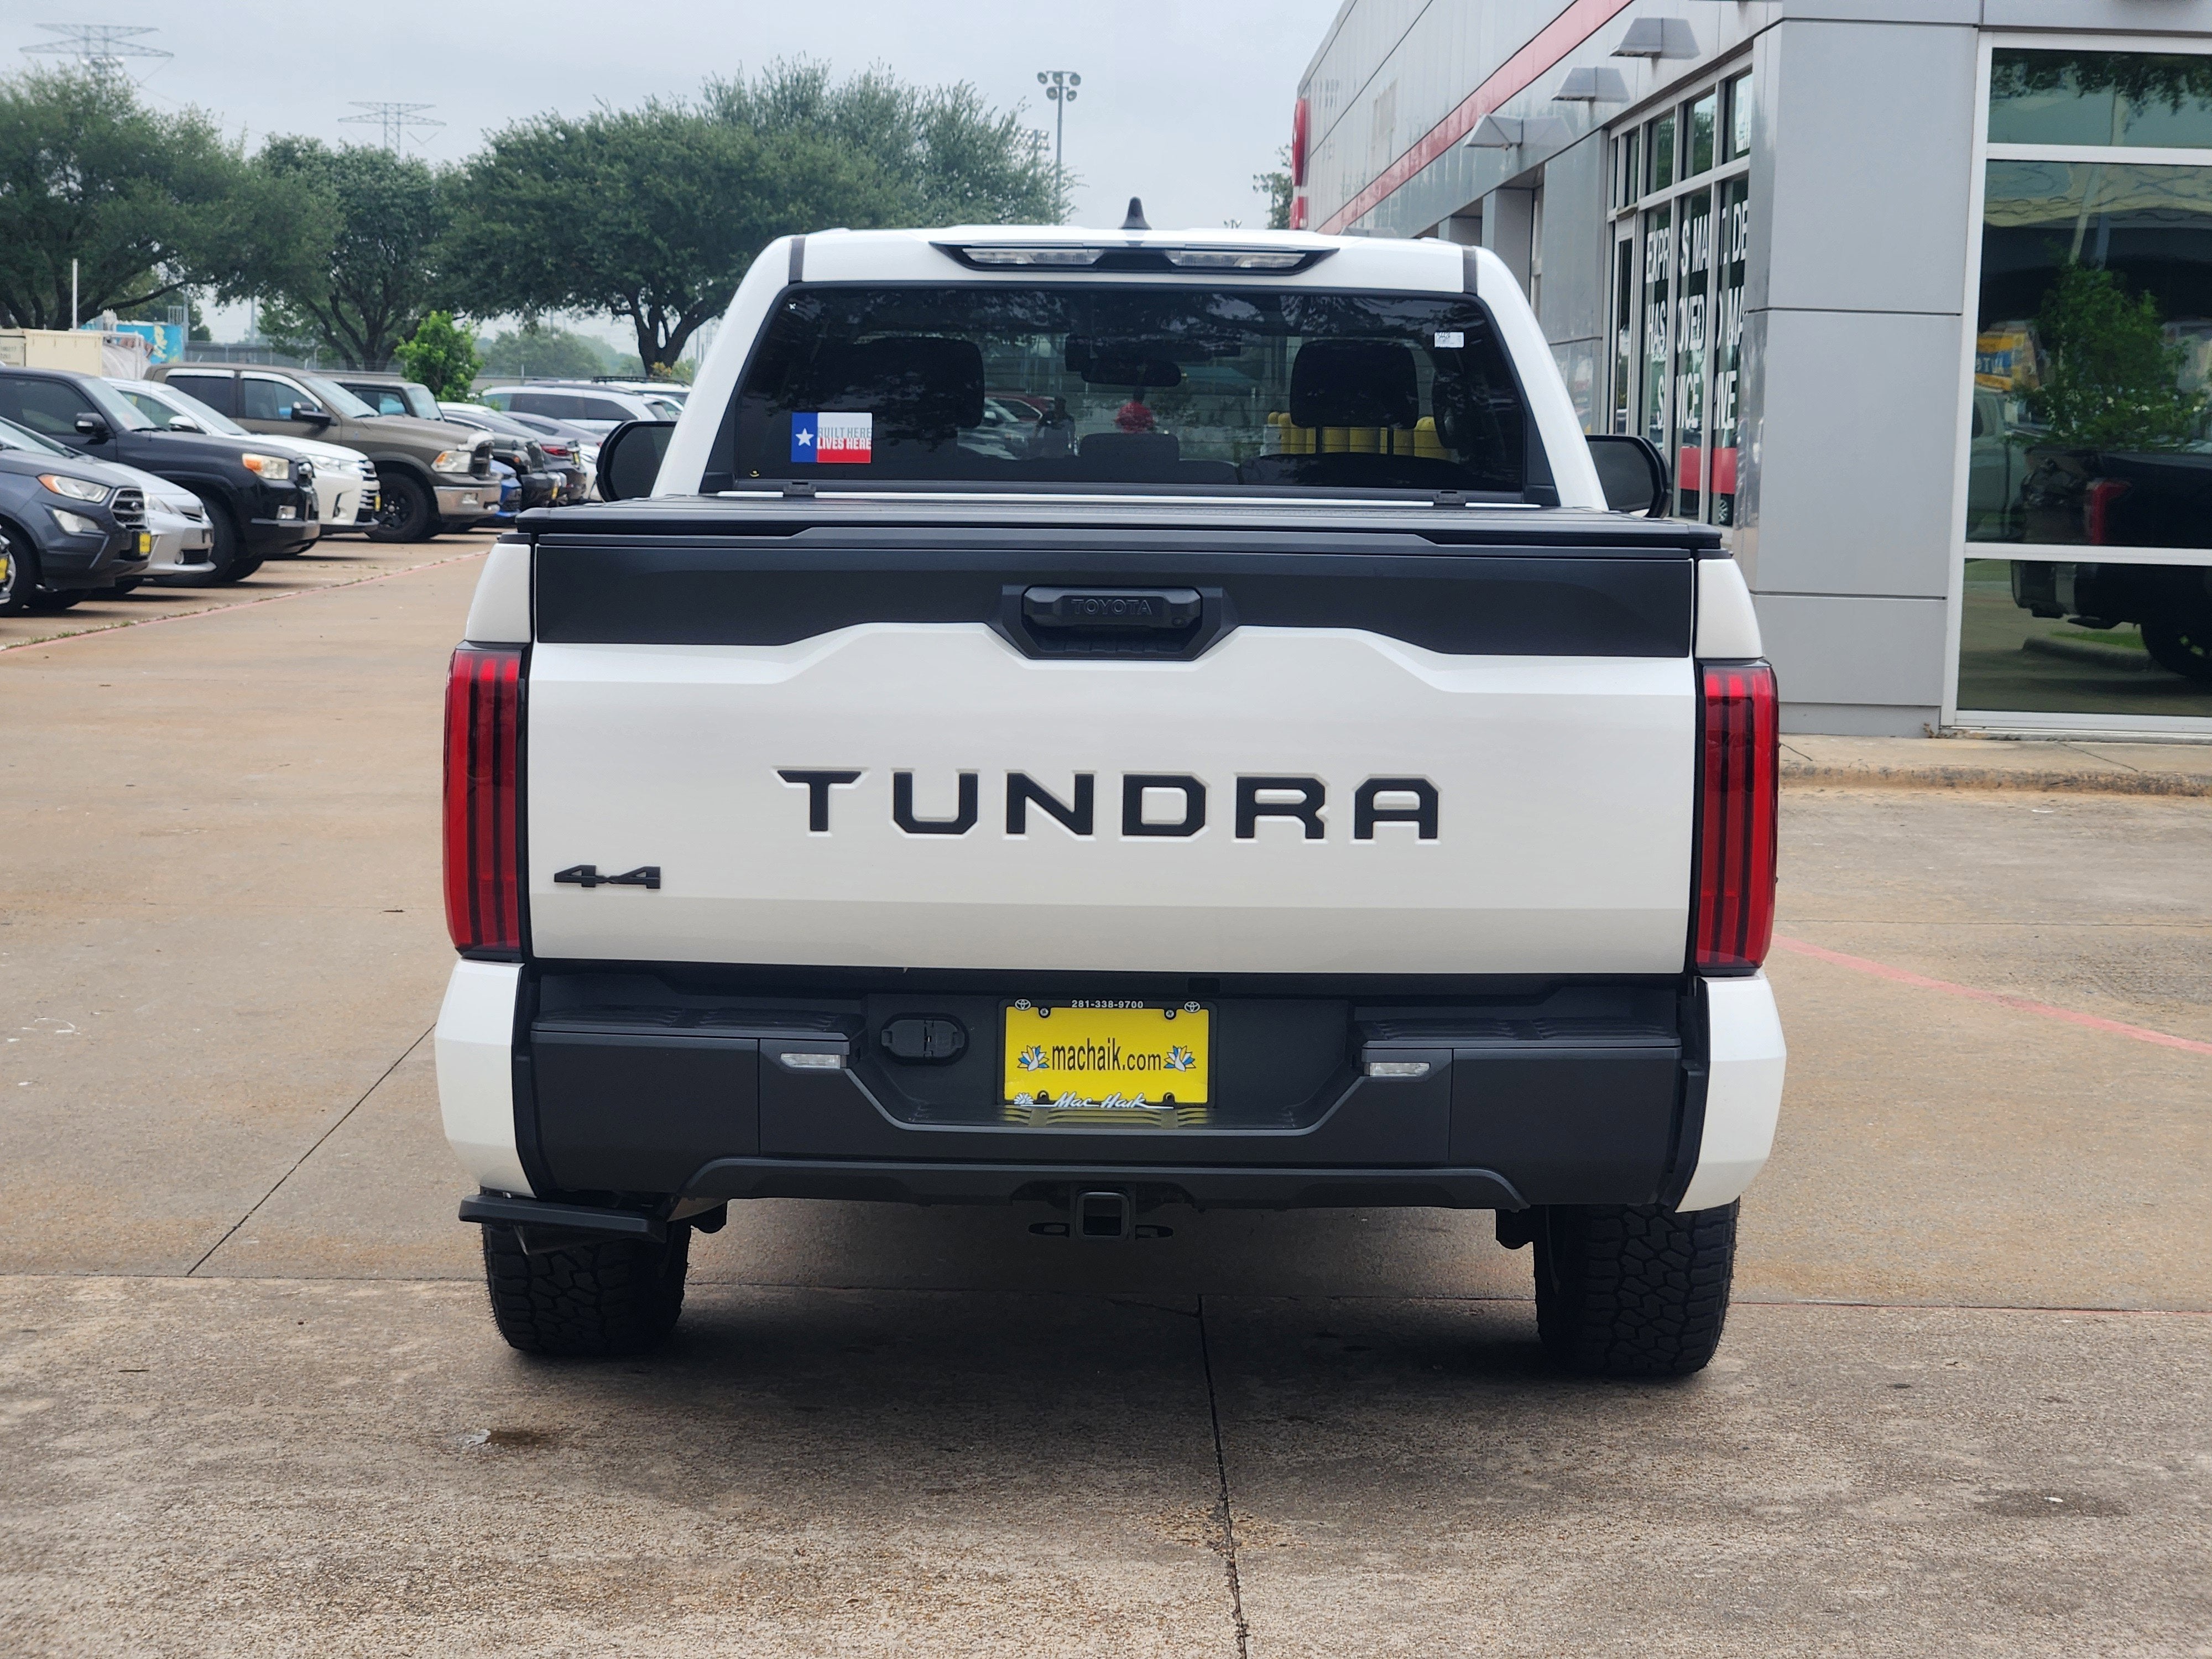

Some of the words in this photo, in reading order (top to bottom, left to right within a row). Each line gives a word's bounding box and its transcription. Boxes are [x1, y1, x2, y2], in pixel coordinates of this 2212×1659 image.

[1646, 218, 1690, 283] EXPRS
[1732, 200, 1748, 263] DE
[1646, 300, 1666, 355] HAS
[1677, 293, 1705, 354] OVED
[1657, 372, 1699, 430] SVICE
[1714, 370, 1736, 430] IVE
[817, 437, 844, 450] LIVES
[846, 438, 872, 450] HERE
[818, 427, 845, 438] BUILT
[848, 427, 872, 438] HERE
[1071, 599, 1152, 615] TOYOTA
[776, 770, 1439, 841] TUNDRA
[1072, 999, 1144, 1009] 281-338-9700
[1052, 1037, 1161, 1071] machaik.com
[1053, 1092, 1094, 1108] Mac
[1100, 1092, 1146, 1109] Haik
